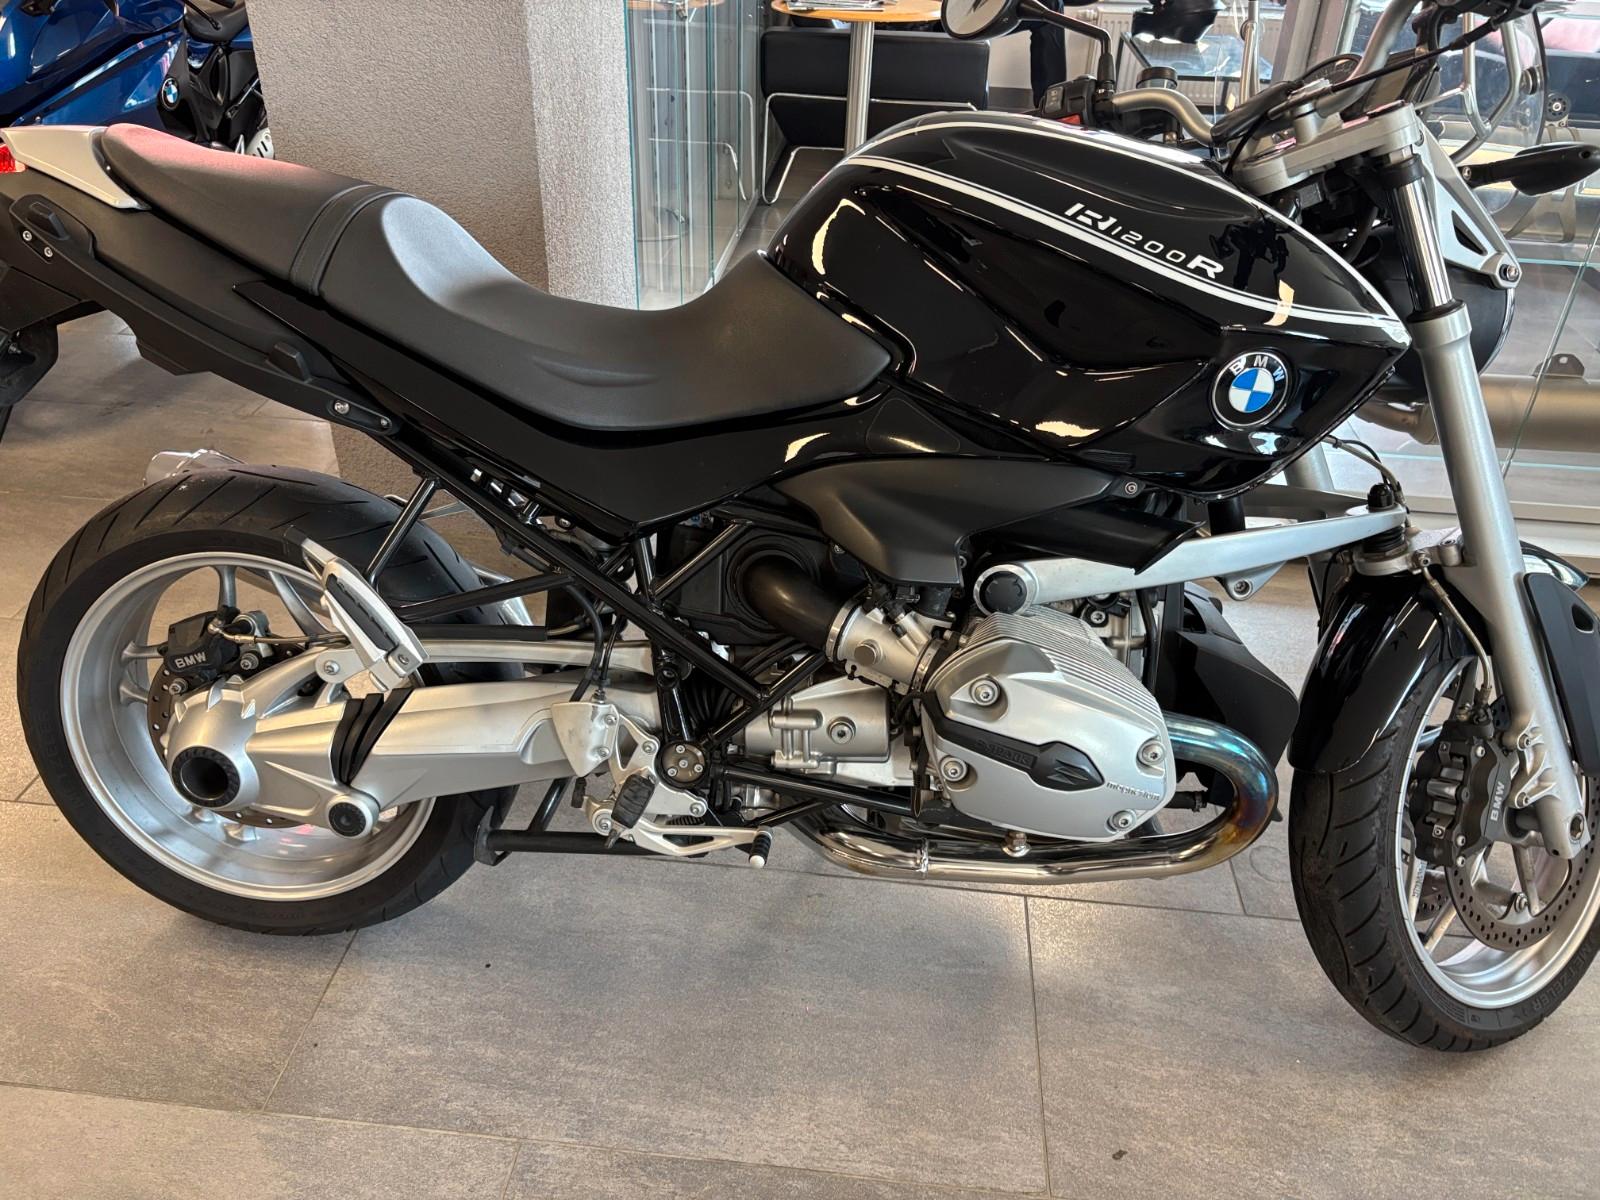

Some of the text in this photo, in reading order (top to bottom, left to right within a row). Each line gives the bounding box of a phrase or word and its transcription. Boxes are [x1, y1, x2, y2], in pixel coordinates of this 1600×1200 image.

[1229, 355, 1285, 382] BMW
[174, 651, 207, 669] BMW
[1490, 781, 1505, 821] BMW
[1531, 942, 1594, 1011] METZELER
